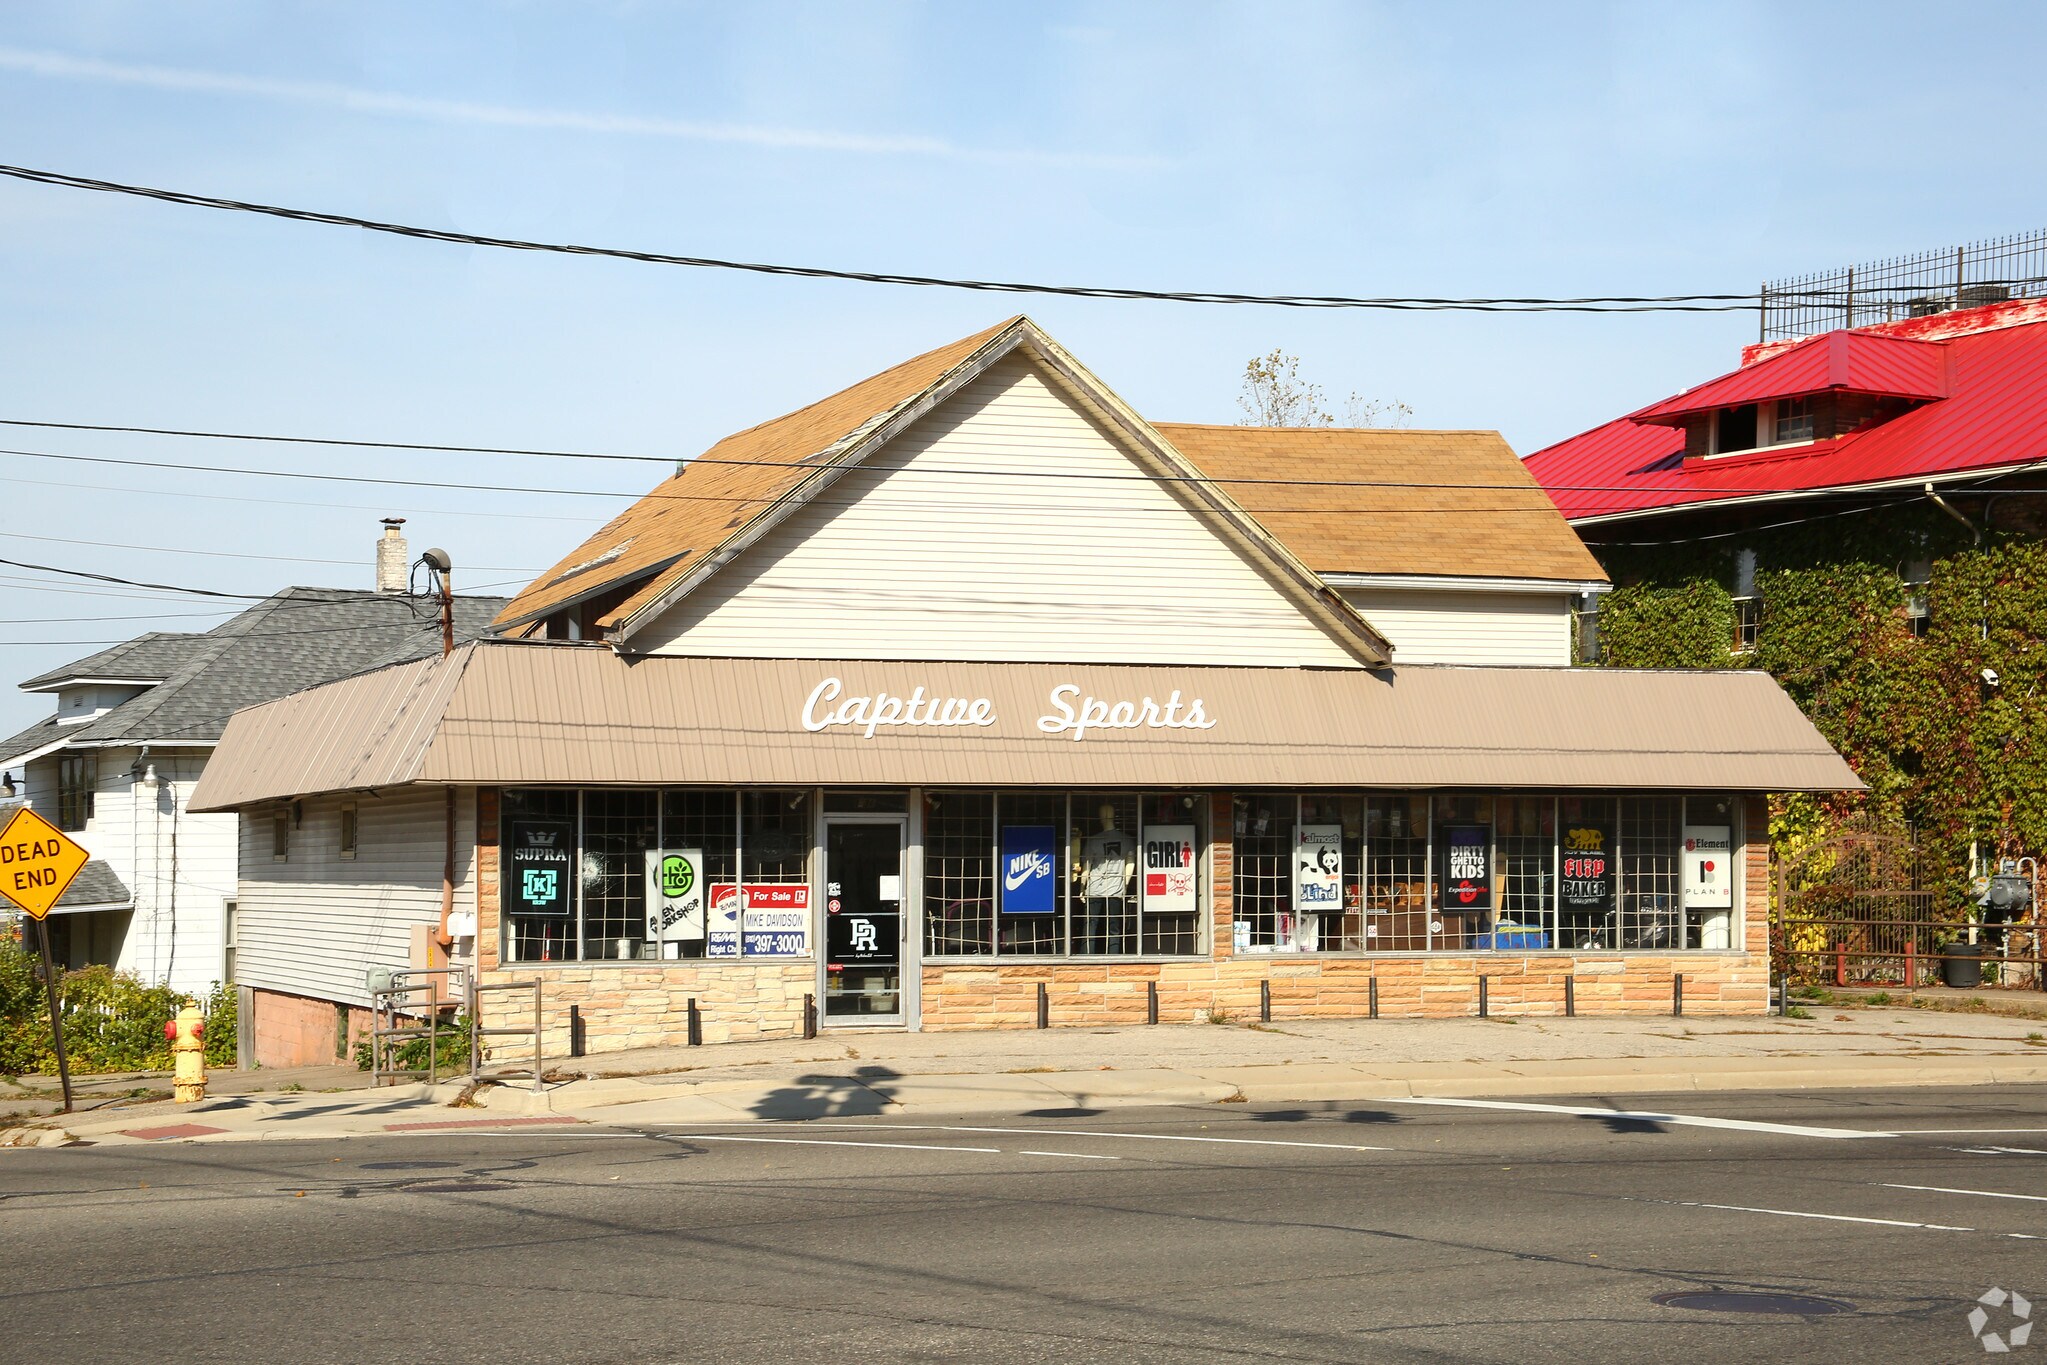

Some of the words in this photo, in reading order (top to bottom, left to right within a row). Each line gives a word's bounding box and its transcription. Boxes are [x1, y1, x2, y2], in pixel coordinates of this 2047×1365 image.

[801, 677, 996, 739] Captive
[1037, 684, 1218, 742] Sports
[1305, 832, 1340, 844] almost
[1696, 838, 1729, 849] Element
[1, 838, 61, 864] DEAD
[515, 847, 567, 861] SUPRA
[1146, 841, 1184, 868] GIRL
[1450, 845, 1485, 857] DIRTY
[1010, 849, 1040, 875] NIKE
[1036, 862, 1051, 879] SB
[1450, 856, 1485, 866] GHETTO
[1450, 864, 1485, 879] KIDS
[15, 867, 58, 891] END
[753, 891, 768, 901] For
[771, 891, 791, 901] Sale
[1562, 880, 1606, 898] BAKER
[745, 913, 763, 927] MIKE
[766, 913, 804, 927] DAVIDSON
[710, 945, 726, 954] Right
[754, 934, 803, 953] 397-3000
